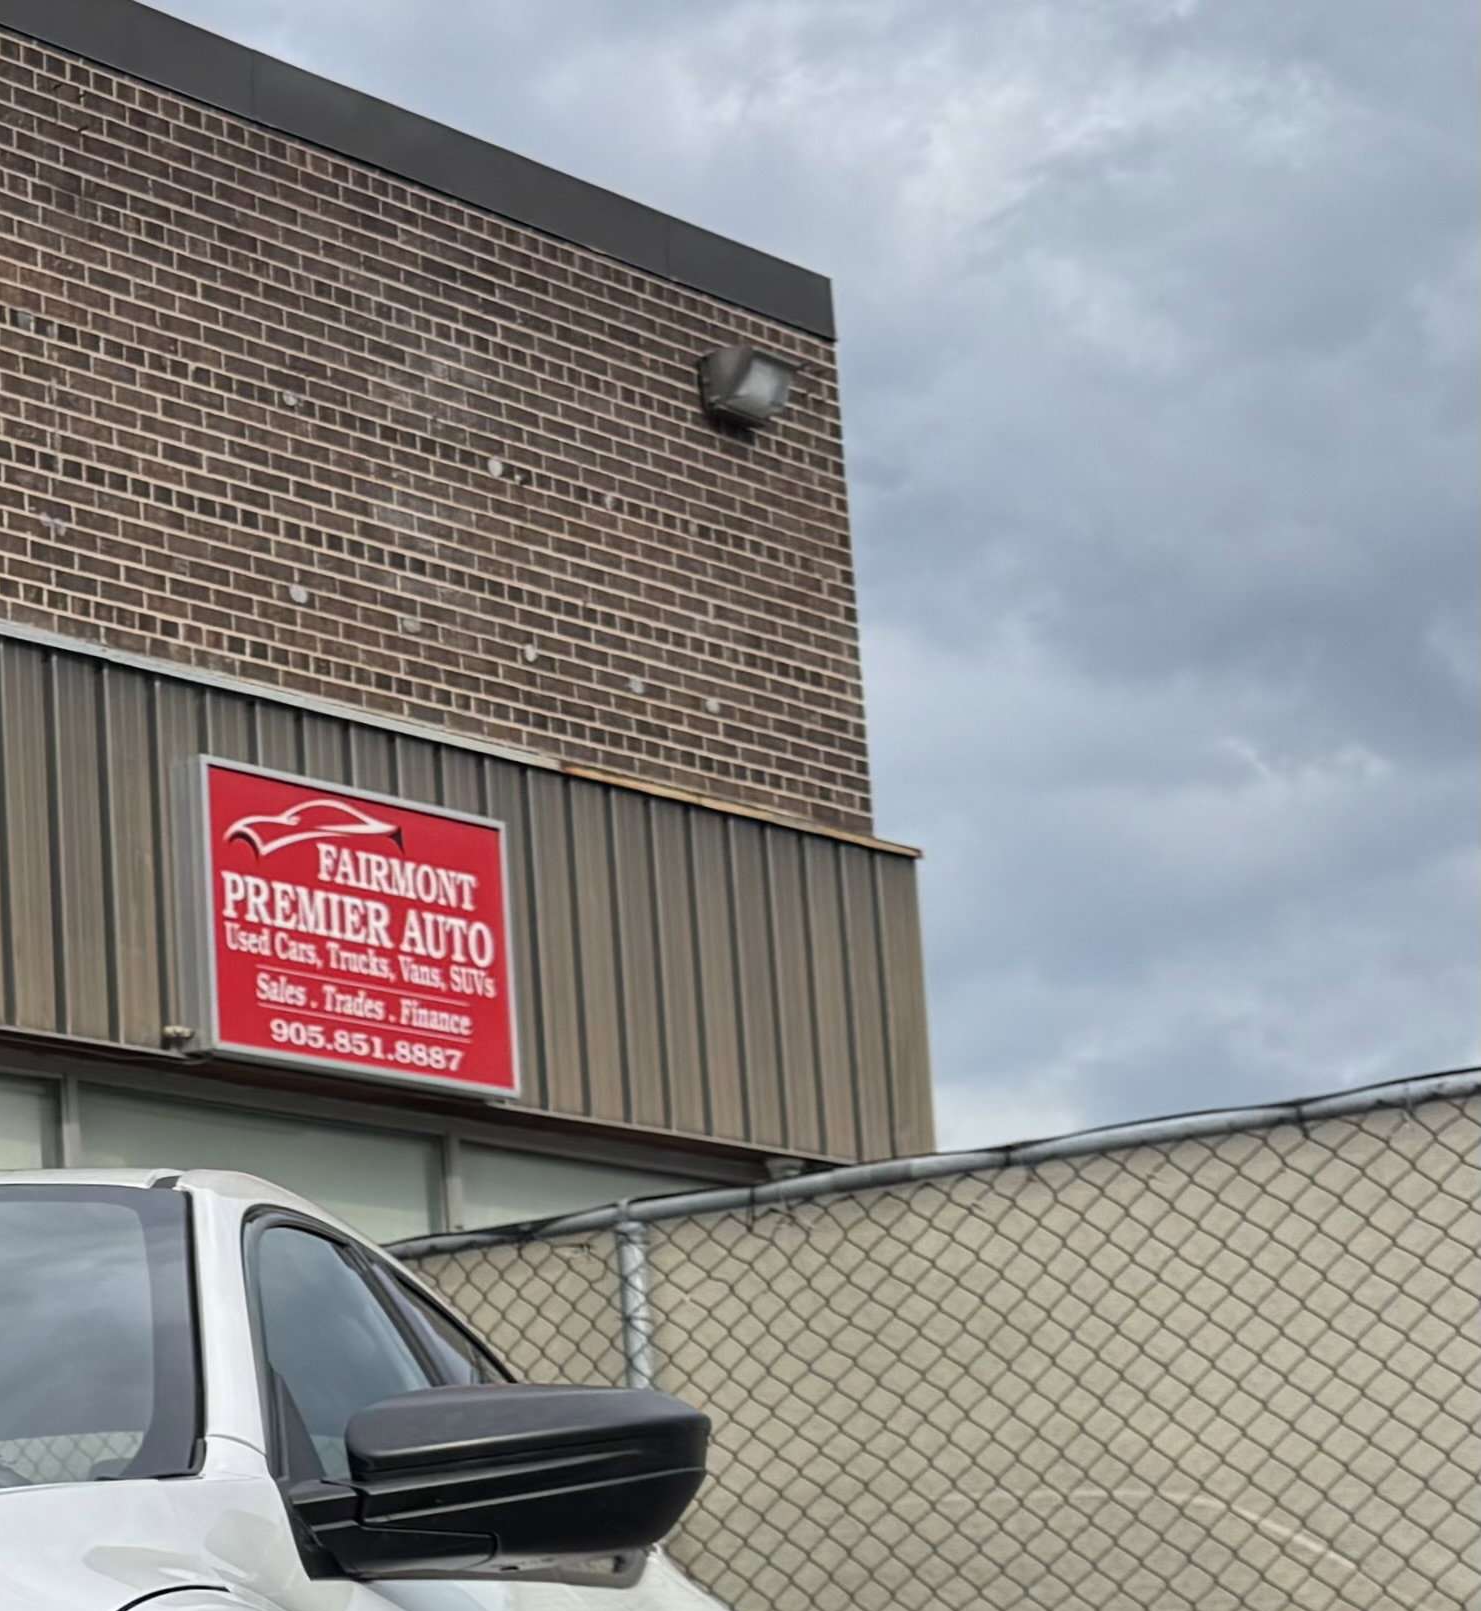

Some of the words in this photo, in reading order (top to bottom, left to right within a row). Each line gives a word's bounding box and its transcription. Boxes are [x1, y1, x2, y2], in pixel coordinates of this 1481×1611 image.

[316, 842, 478, 911] FAIRMONT
[220, 871, 392, 949] PREMIER
[400, 909, 495, 969] AUTO
[223, 921, 271, 956] Used
[274, 931, 323, 970] Cars,
[325, 942, 396, 983] Trucks,
[397, 955, 447, 992] Vans,
[450, 968, 497, 999] SUVs
[255, 972, 307, 1009] Sales
[322, 984, 385, 1022] Trades
[399, 999, 473, 1036] Finance
[269, 1018, 463, 1071] 905.851.8887
